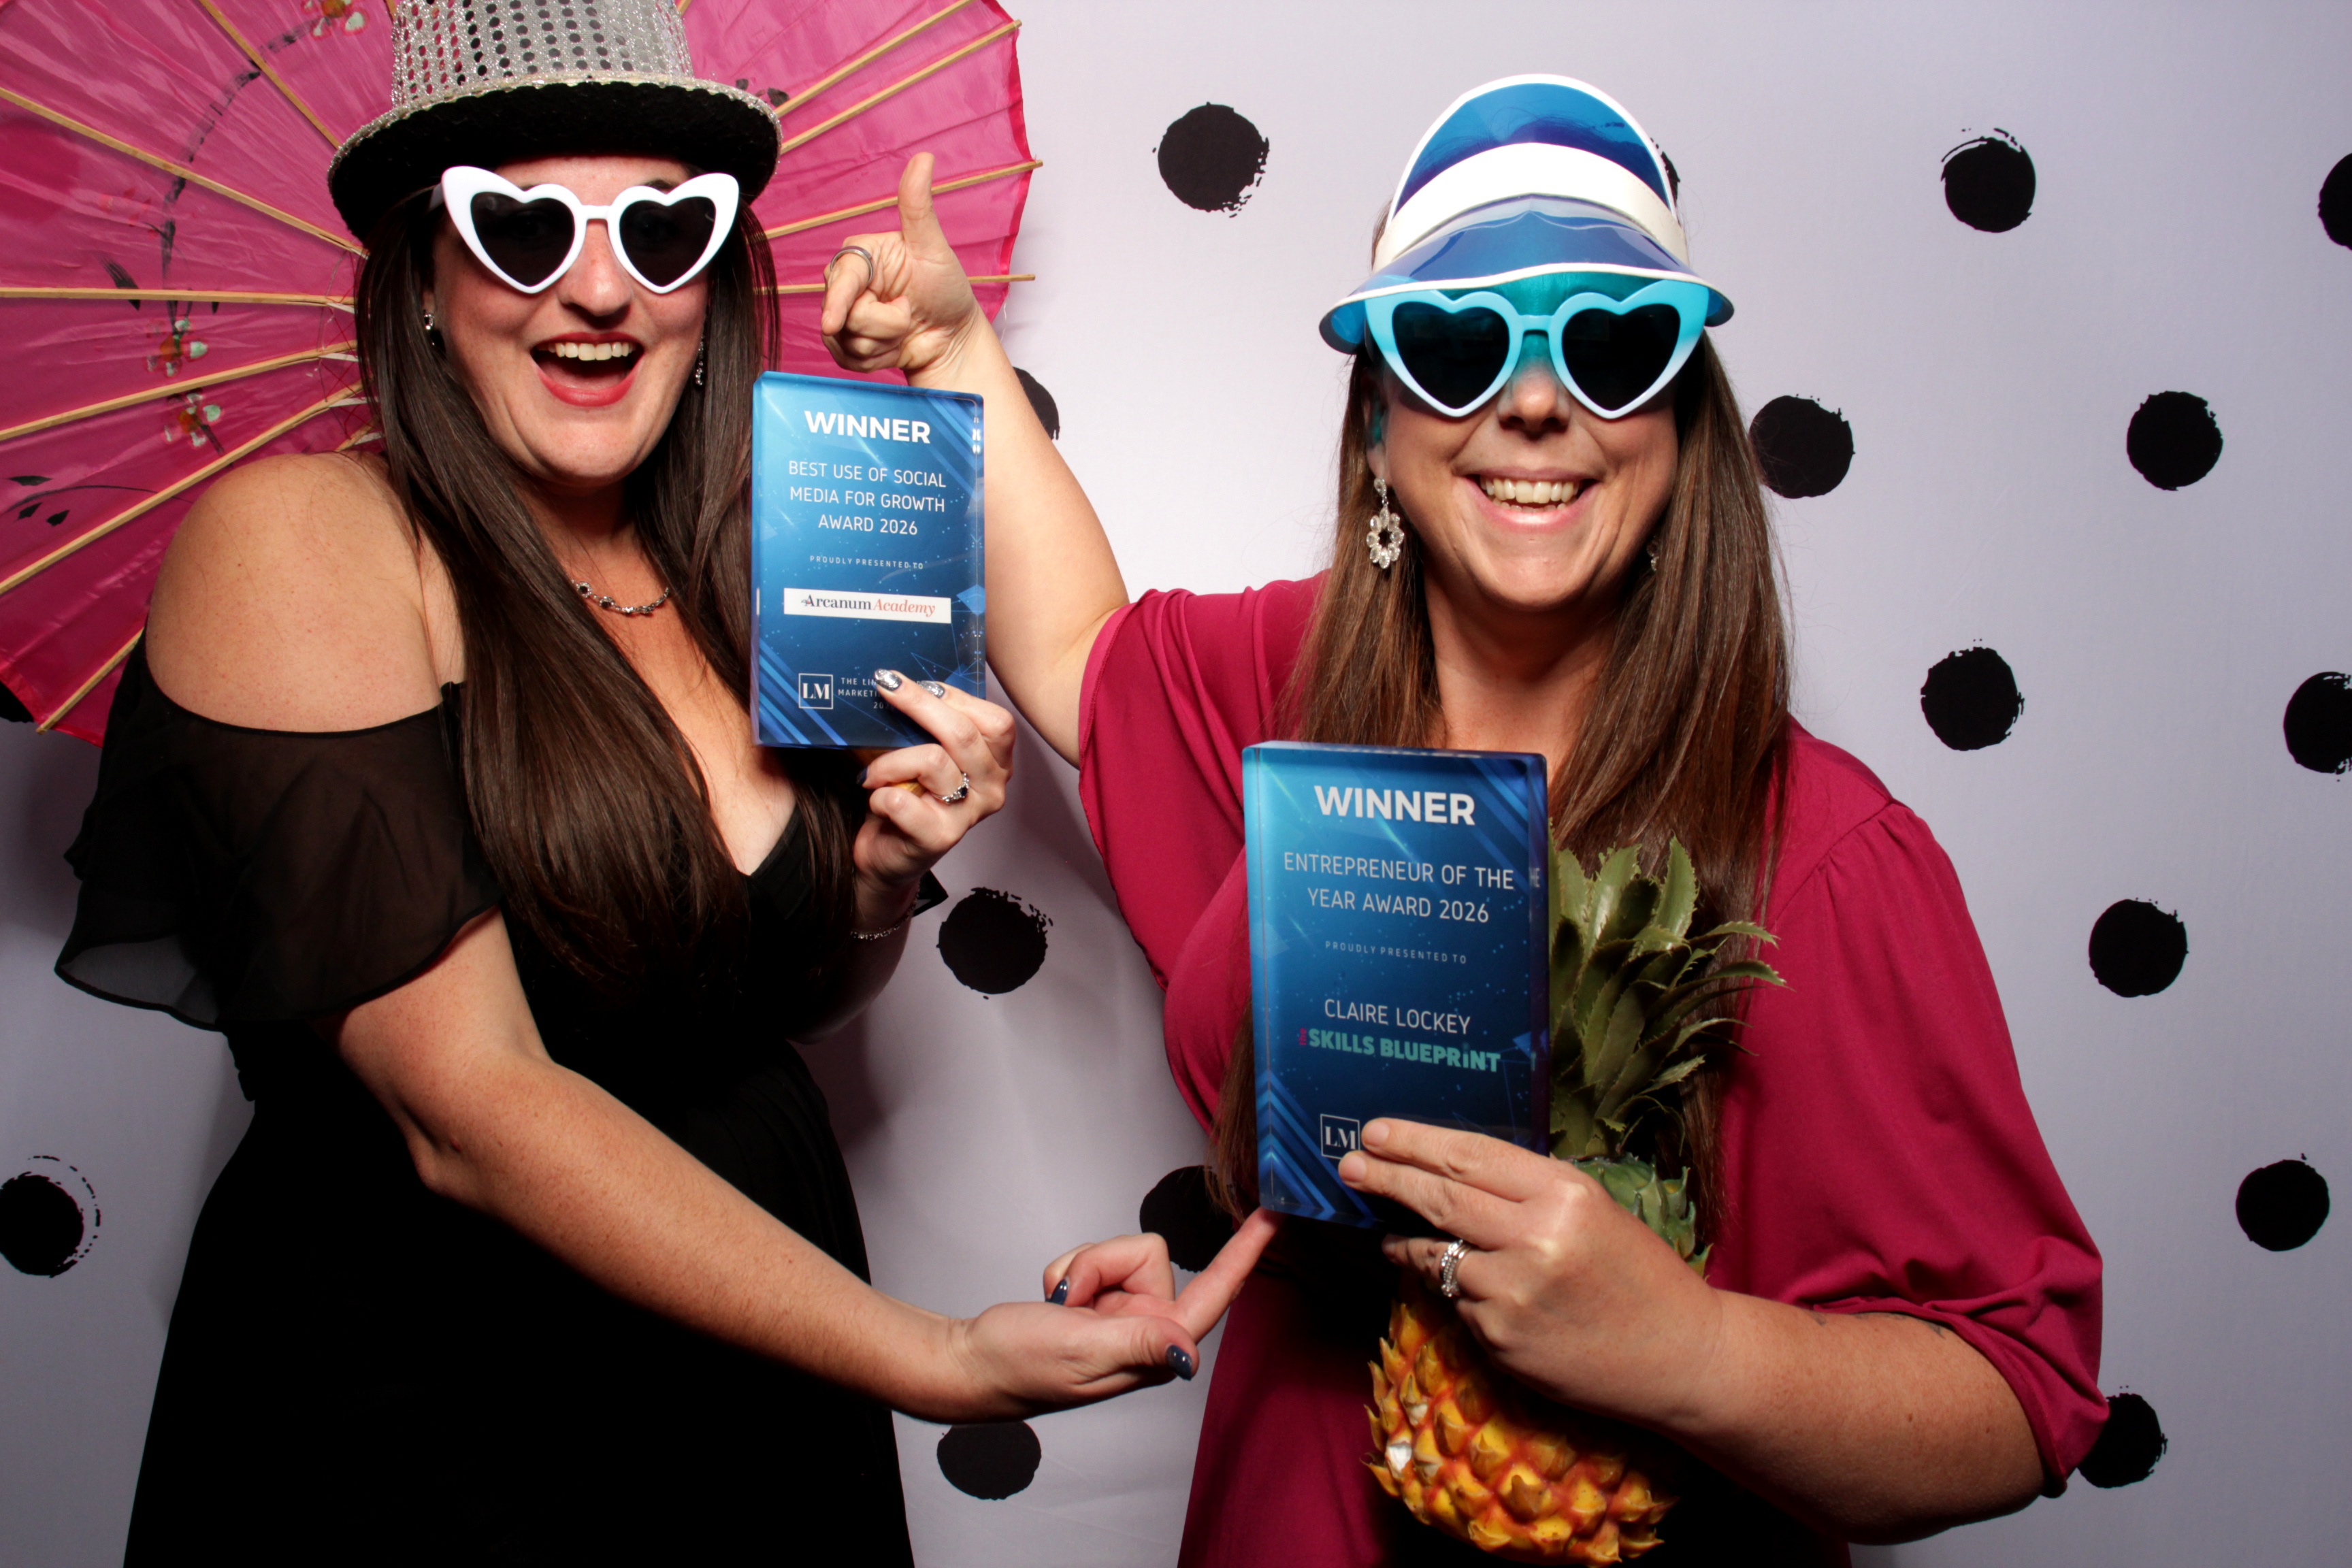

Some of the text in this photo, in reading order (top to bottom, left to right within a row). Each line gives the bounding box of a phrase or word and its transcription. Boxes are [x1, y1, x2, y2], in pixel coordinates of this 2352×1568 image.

[804, 410, 931, 444] WINNER
[788, 460, 947, 488] BEST USE OF SOCIAL
[790, 486, 945, 512] MEDIA FOR GROWTH
[818, 514, 918, 536] AWARD 2026
[809, 555, 852, 565] PROUDLY
[855, 558, 909, 569] PRESENTED
[802, 593, 936, 618] Arcanum Academy
[802, 683, 830, 700] LM
[838, 689, 881, 698] MARKETI
[840, 677, 858, 685] THE
[1314, 785, 1475, 826] WINNER
[1284, 851, 1515, 890] ENTREPRENEUR OF THE
[1307, 887, 1490, 924] YEAR AWARD 2026
[1325, 941, 1467, 964] PROUDLY PRESENTED TO
[1324, 998, 1471, 1035] CLAIRE LOCKEY
[1308, 1028, 1375, 1056] SKILLS
[1324, 1126, 1356, 1150] LM
